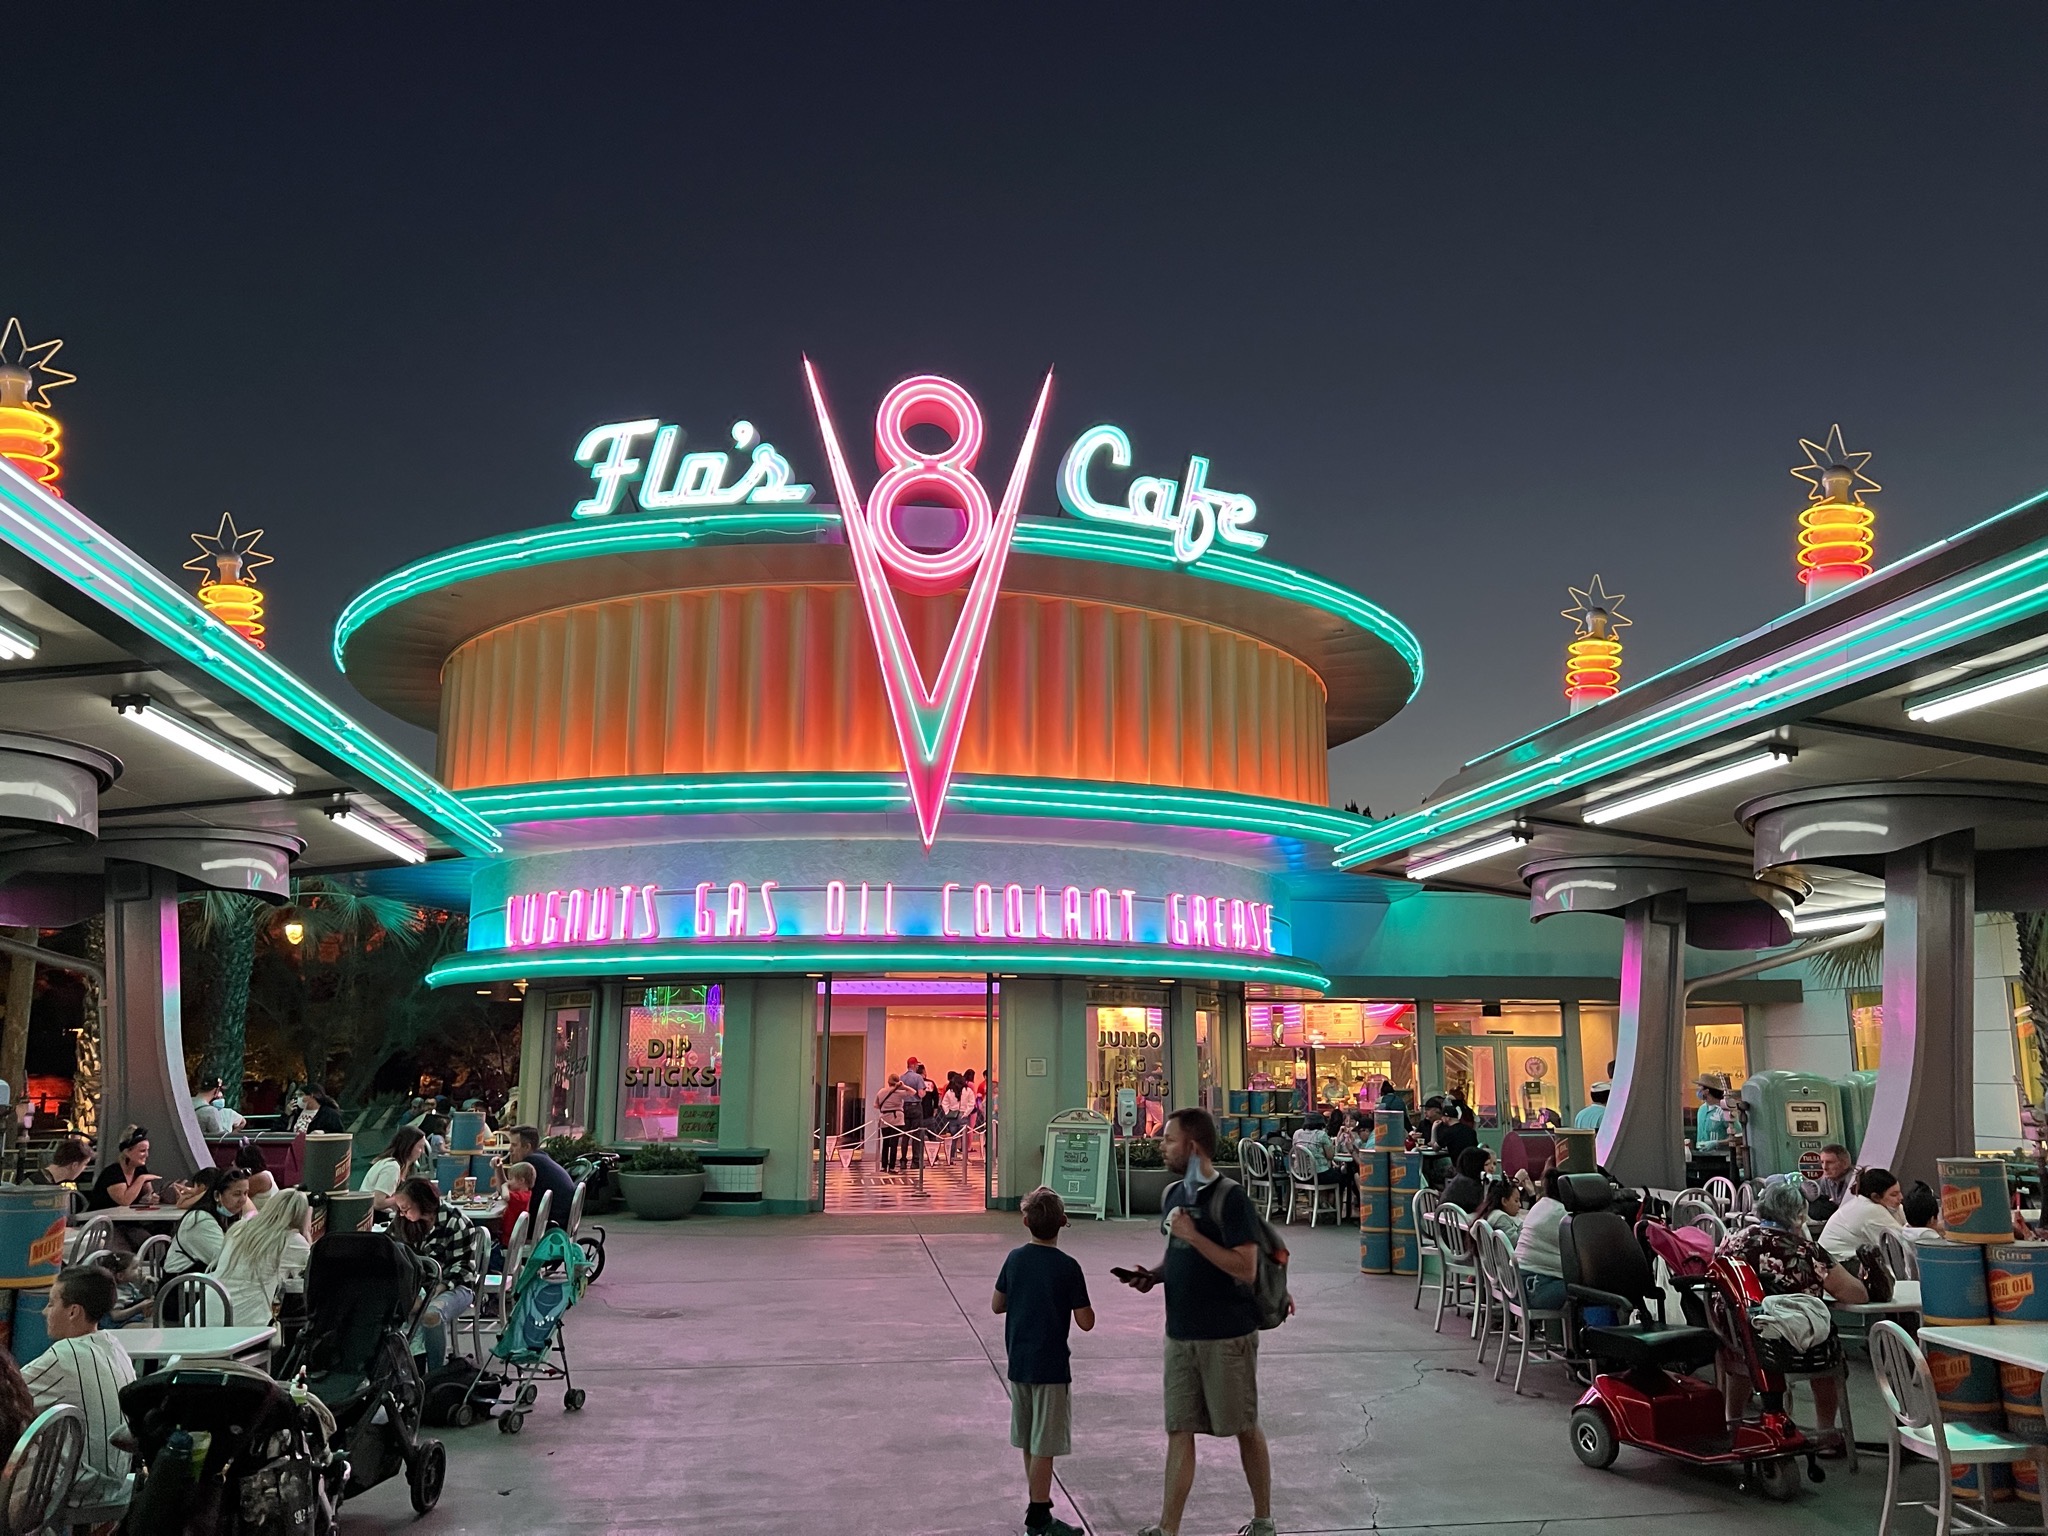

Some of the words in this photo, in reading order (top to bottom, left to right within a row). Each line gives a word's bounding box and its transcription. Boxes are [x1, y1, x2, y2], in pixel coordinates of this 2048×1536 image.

[572, 418, 816, 521] Flo's
[1057, 424, 1267, 563] Cafe
[505, 884, 661, 947] LUGNUTS
[695, 881, 779, 937] GAS
[825, 880, 897, 937] OIL
[942, 882, 1136, 941] COOLANT
[1165, 892, 1277, 953] GREASE
[647, 1038, 692, 1059] DIP
[1097, 1031, 1161, 1048] JUMBO
[1115, 1055, 1147, 1073] BIG
[624, 1066, 716, 1087] STICKS
[1961, 1191, 1980, 1207] OIL
[2012, 1277, 2032, 1293] OIL
